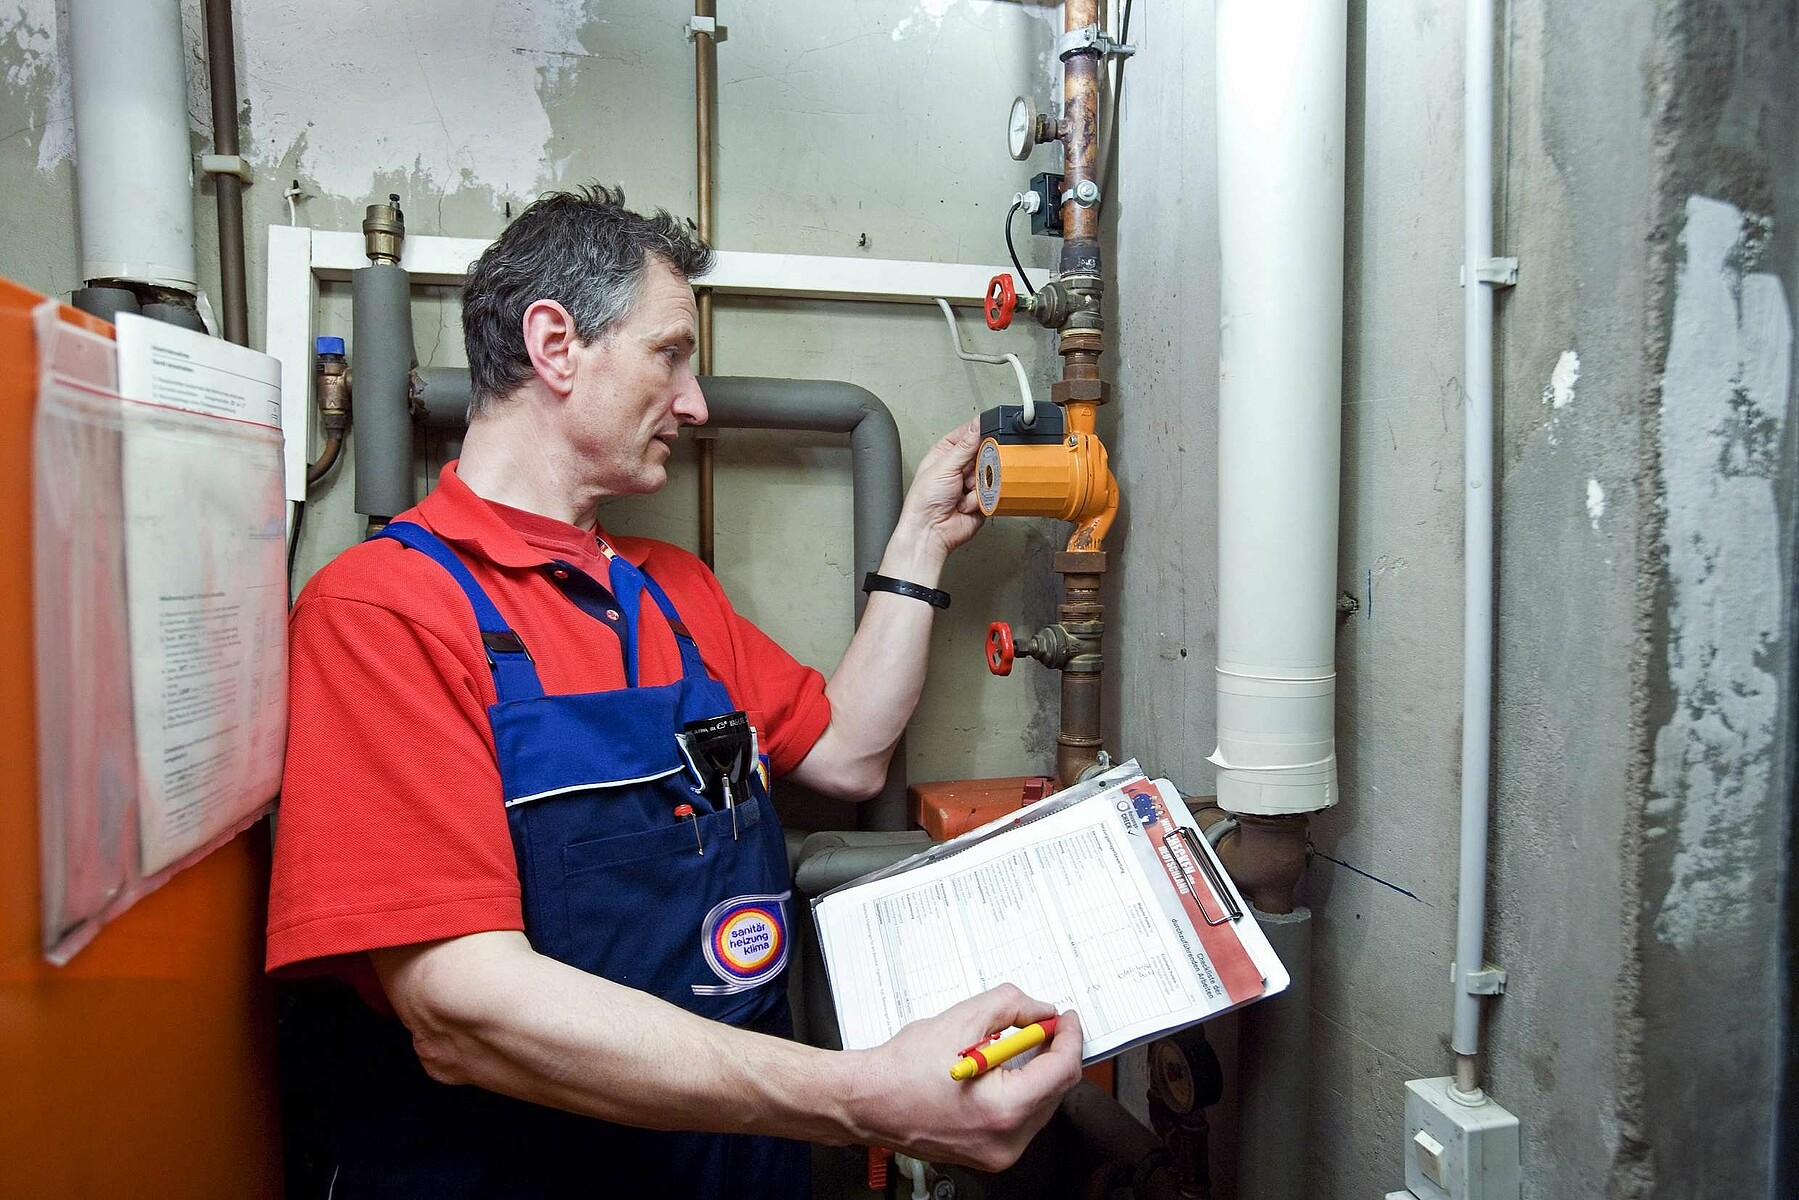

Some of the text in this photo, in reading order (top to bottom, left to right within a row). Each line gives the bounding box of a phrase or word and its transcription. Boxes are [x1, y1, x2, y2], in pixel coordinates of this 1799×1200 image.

[1120, 813, 1132, 829] CHECK
[1157, 844, 1189, 895] DEUTSCHLAND
[731, 923, 765, 938] sanitär
[730, 933, 769, 949] heizung
[743, 944, 770, 955] klima
[1170, 917, 1214, 999] durchzuführenden Arbeiten
[1196, 952, 1221, 996] Checkliste der
